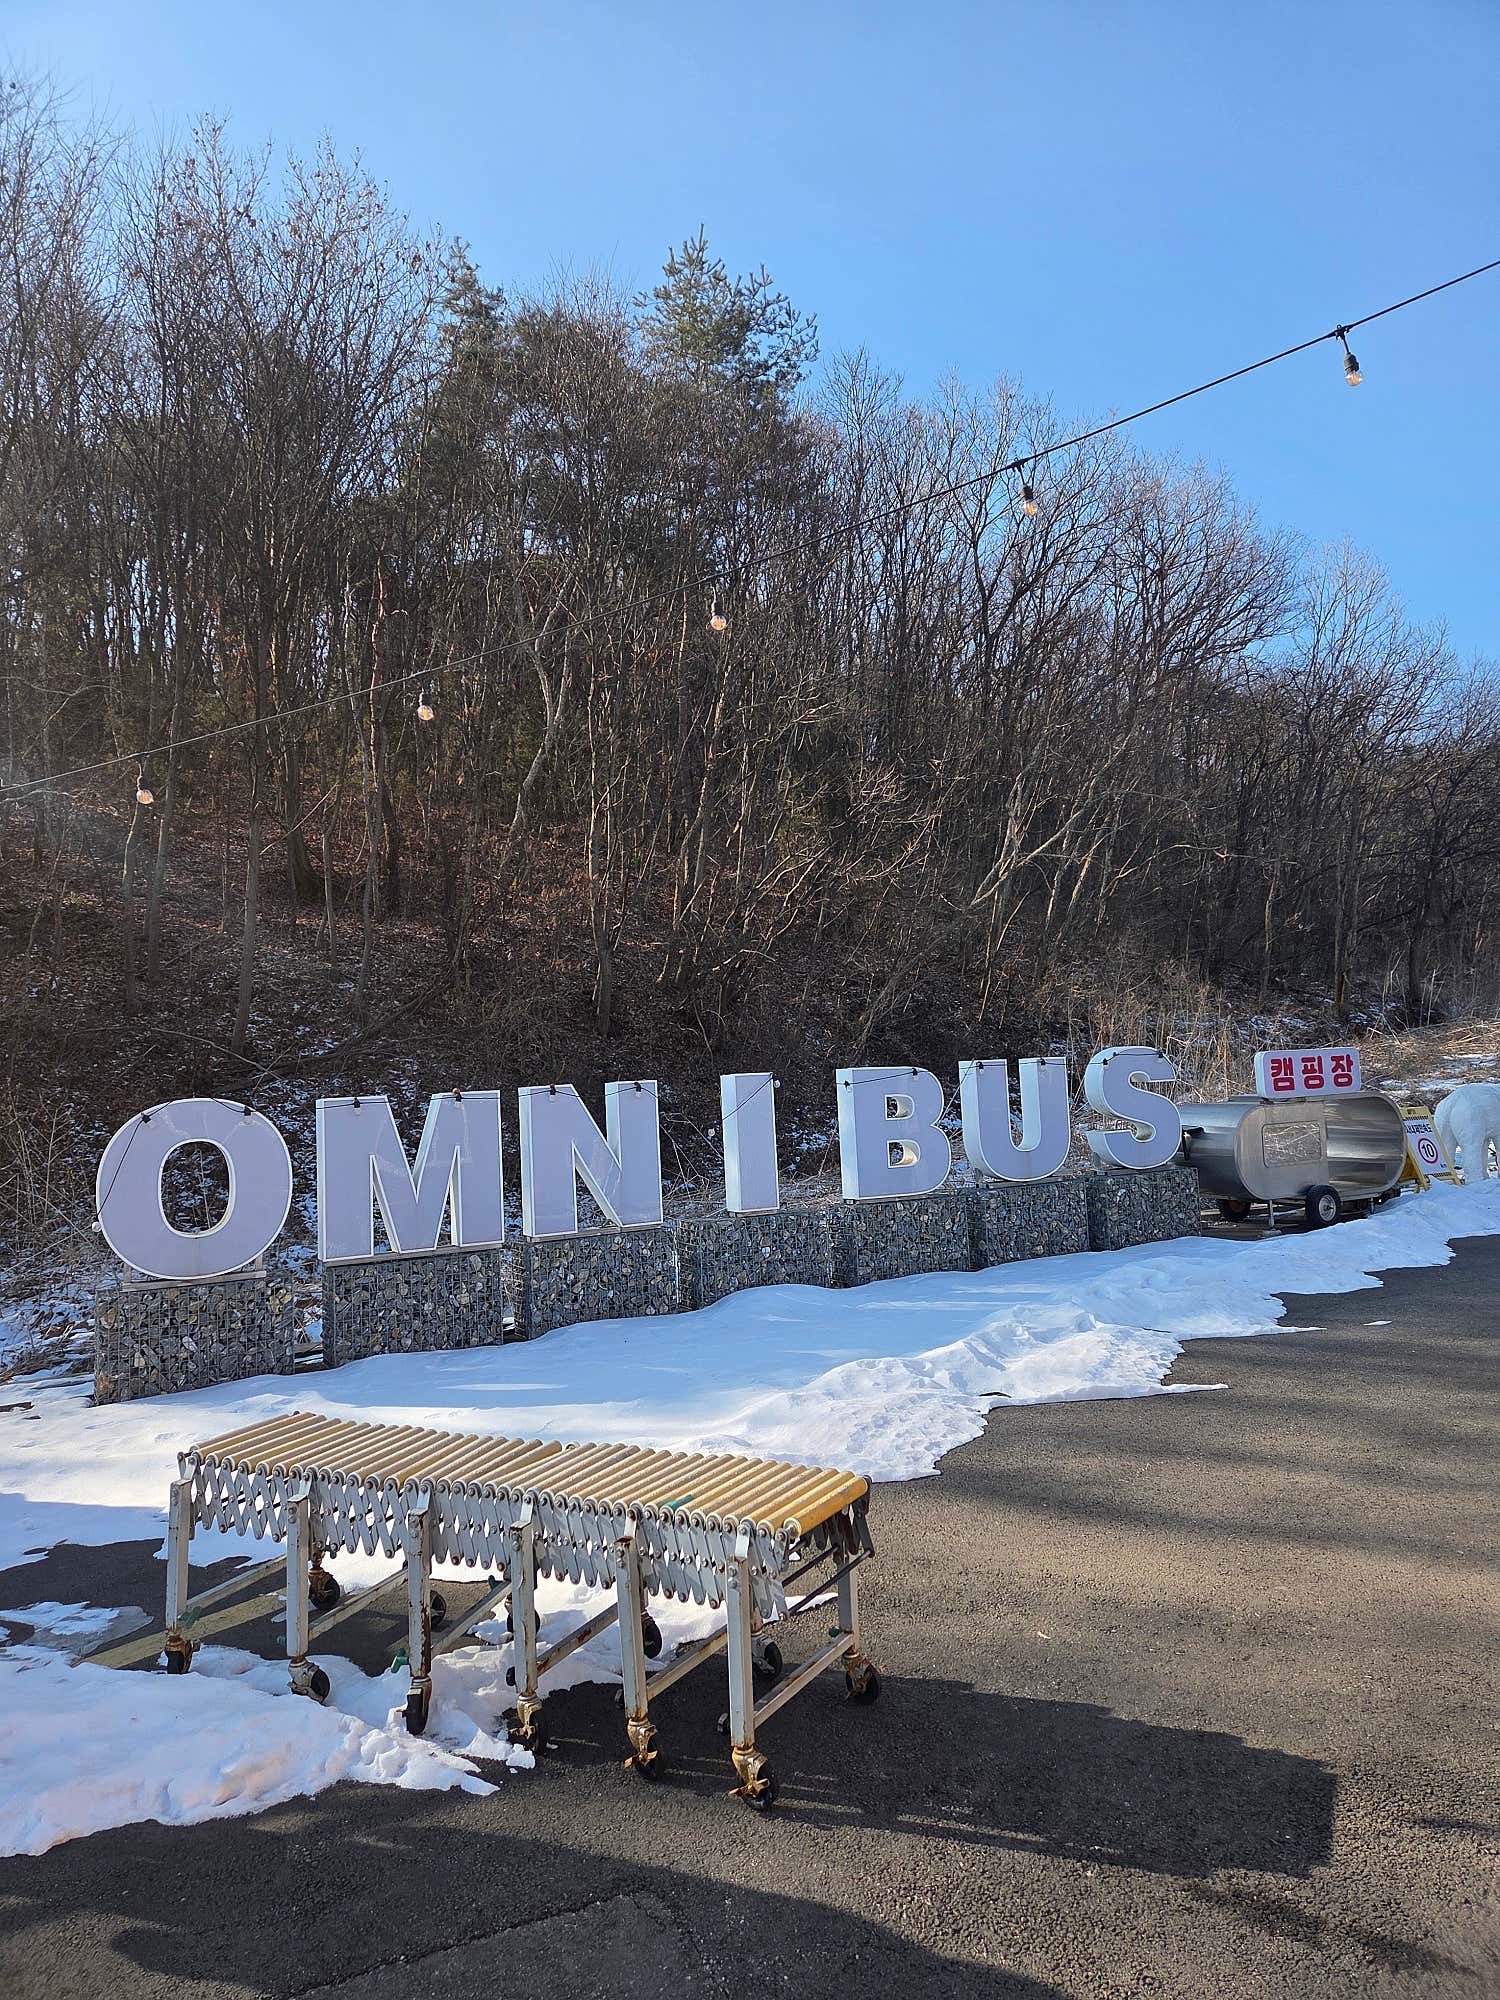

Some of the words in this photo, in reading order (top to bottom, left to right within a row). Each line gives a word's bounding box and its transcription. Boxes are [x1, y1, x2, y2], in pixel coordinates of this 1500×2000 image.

[1270, 1054, 1353, 1091] 캠핑장
[96, 1046, 1182, 1280] OMNIBUS
[1421, 1143, 1434, 1157] 10
